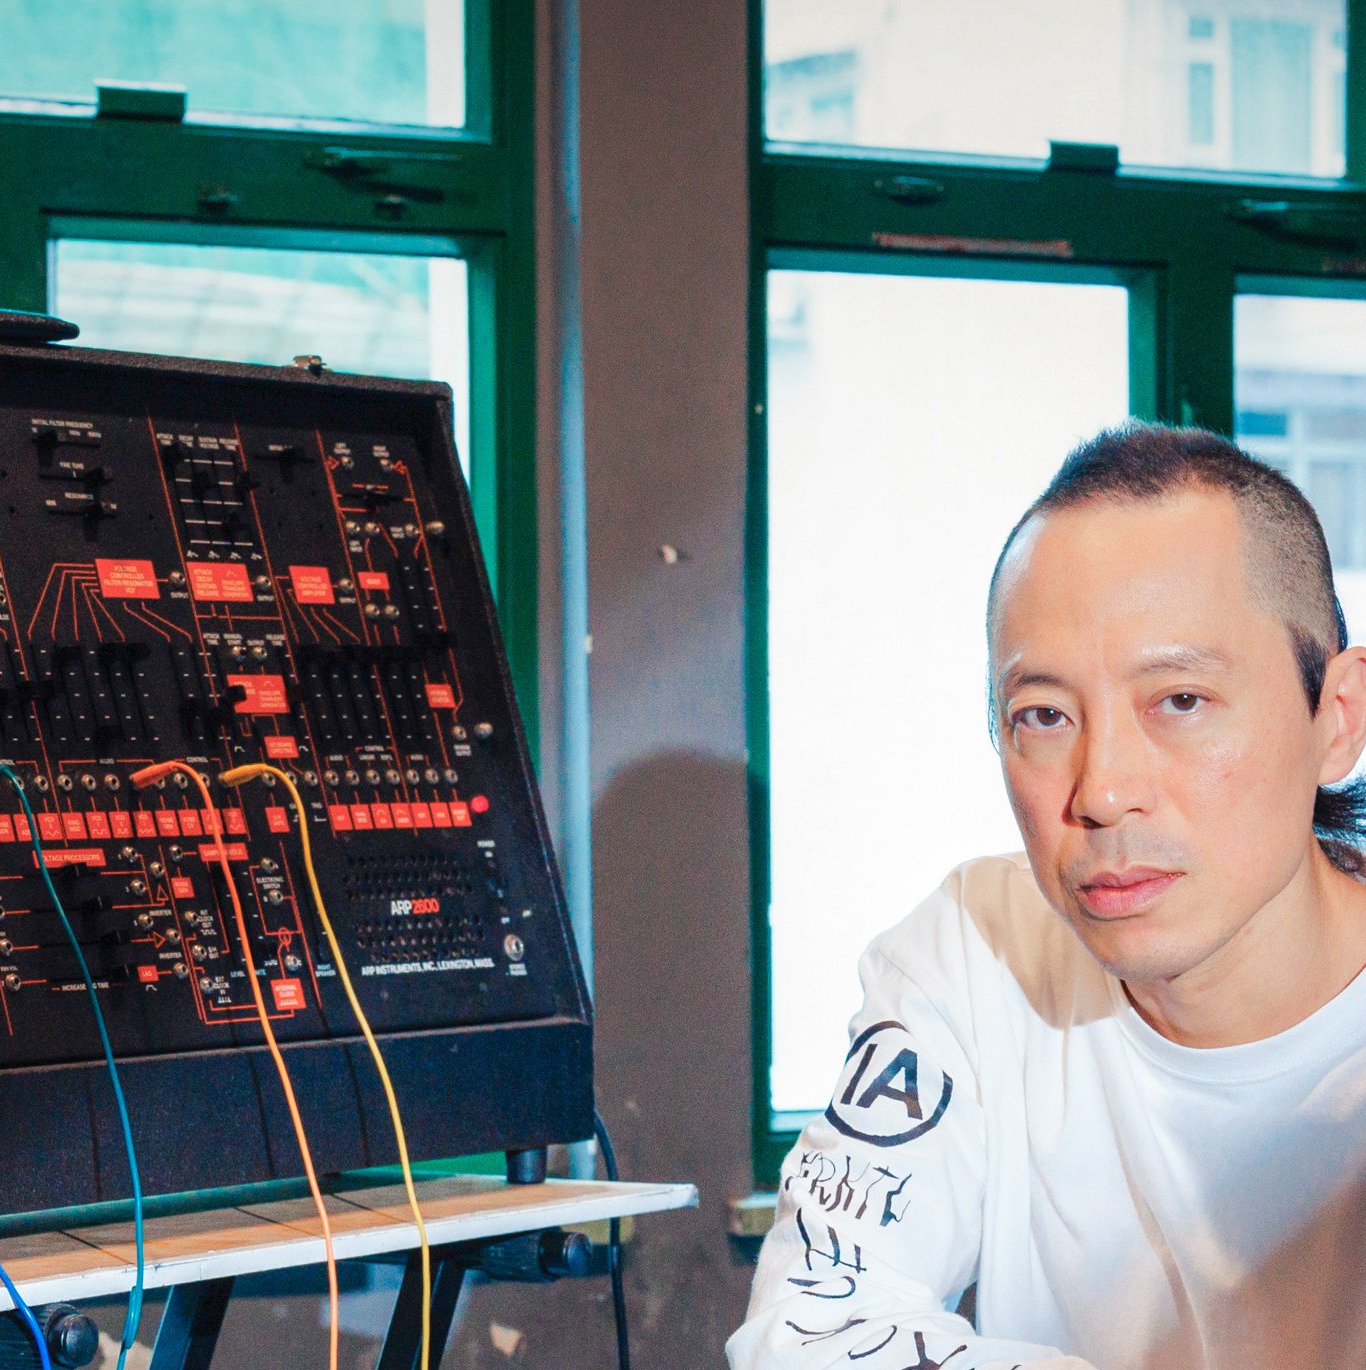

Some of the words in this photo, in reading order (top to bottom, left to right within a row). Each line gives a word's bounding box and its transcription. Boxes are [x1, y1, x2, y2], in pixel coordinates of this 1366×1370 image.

[64, 853, 100, 861] PROCESSORS
[149, 909, 172, 917] INVERTER
[361, 966, 376, 976] ARP
[62, 982, 97, 991] INCREASG
